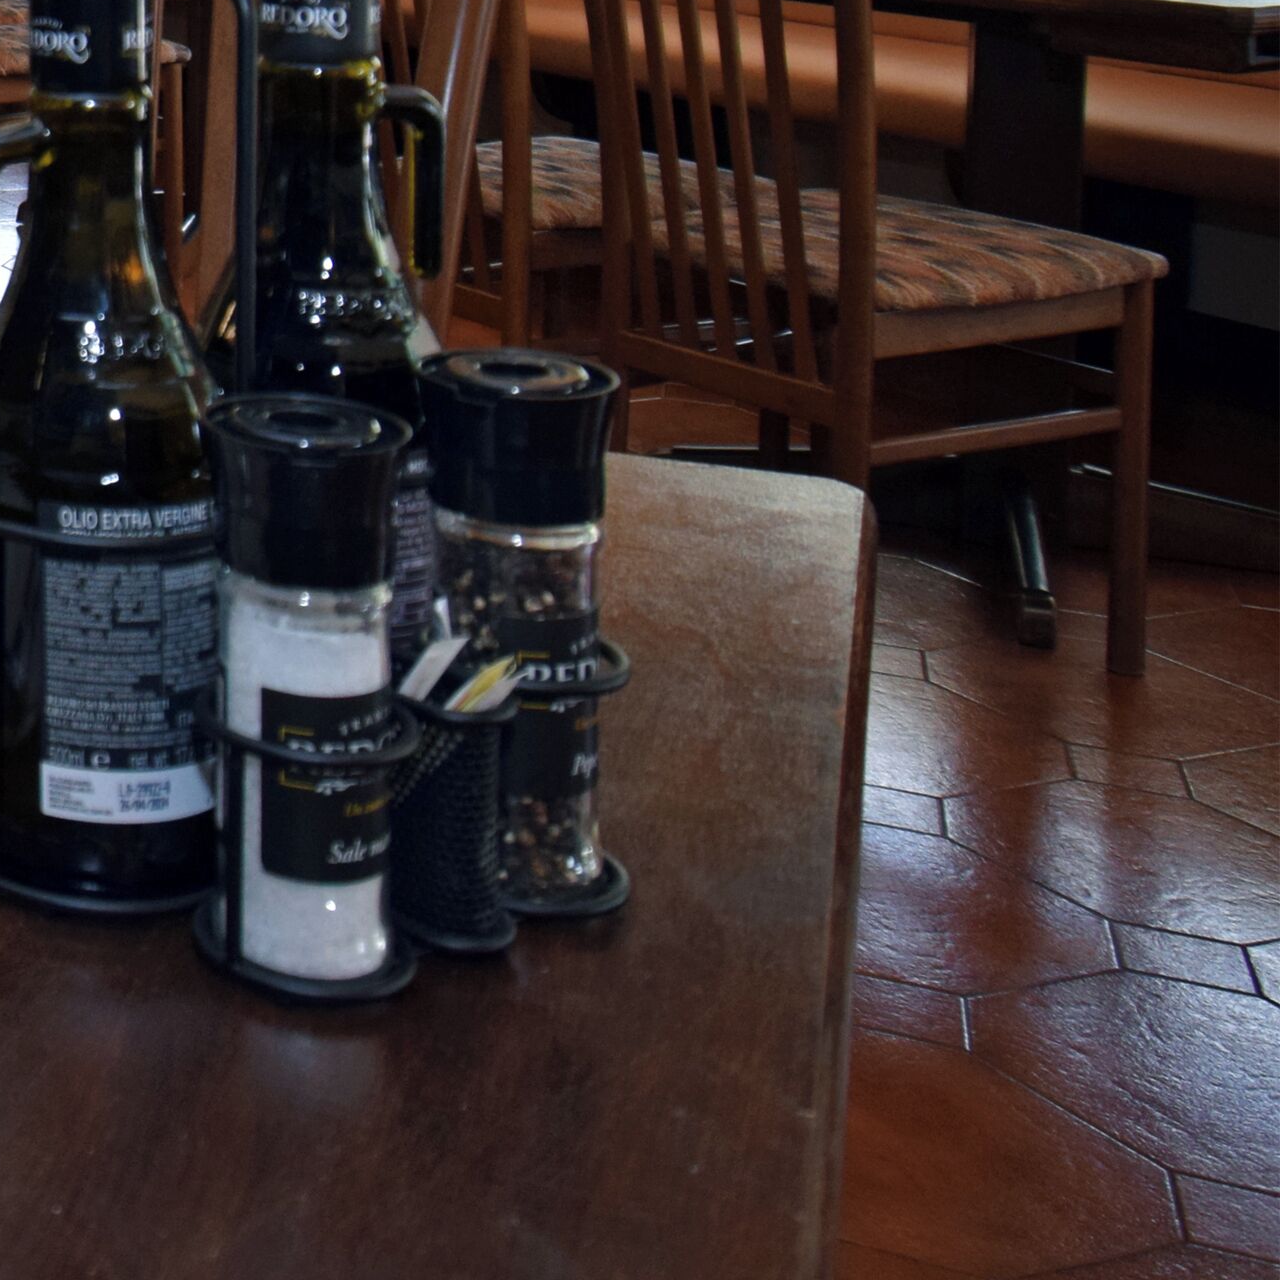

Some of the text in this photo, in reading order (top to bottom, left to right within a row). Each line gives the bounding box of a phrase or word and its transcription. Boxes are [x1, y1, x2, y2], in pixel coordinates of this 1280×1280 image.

[57, 501, 209, 532] OLIO EXTRA VERGINE
